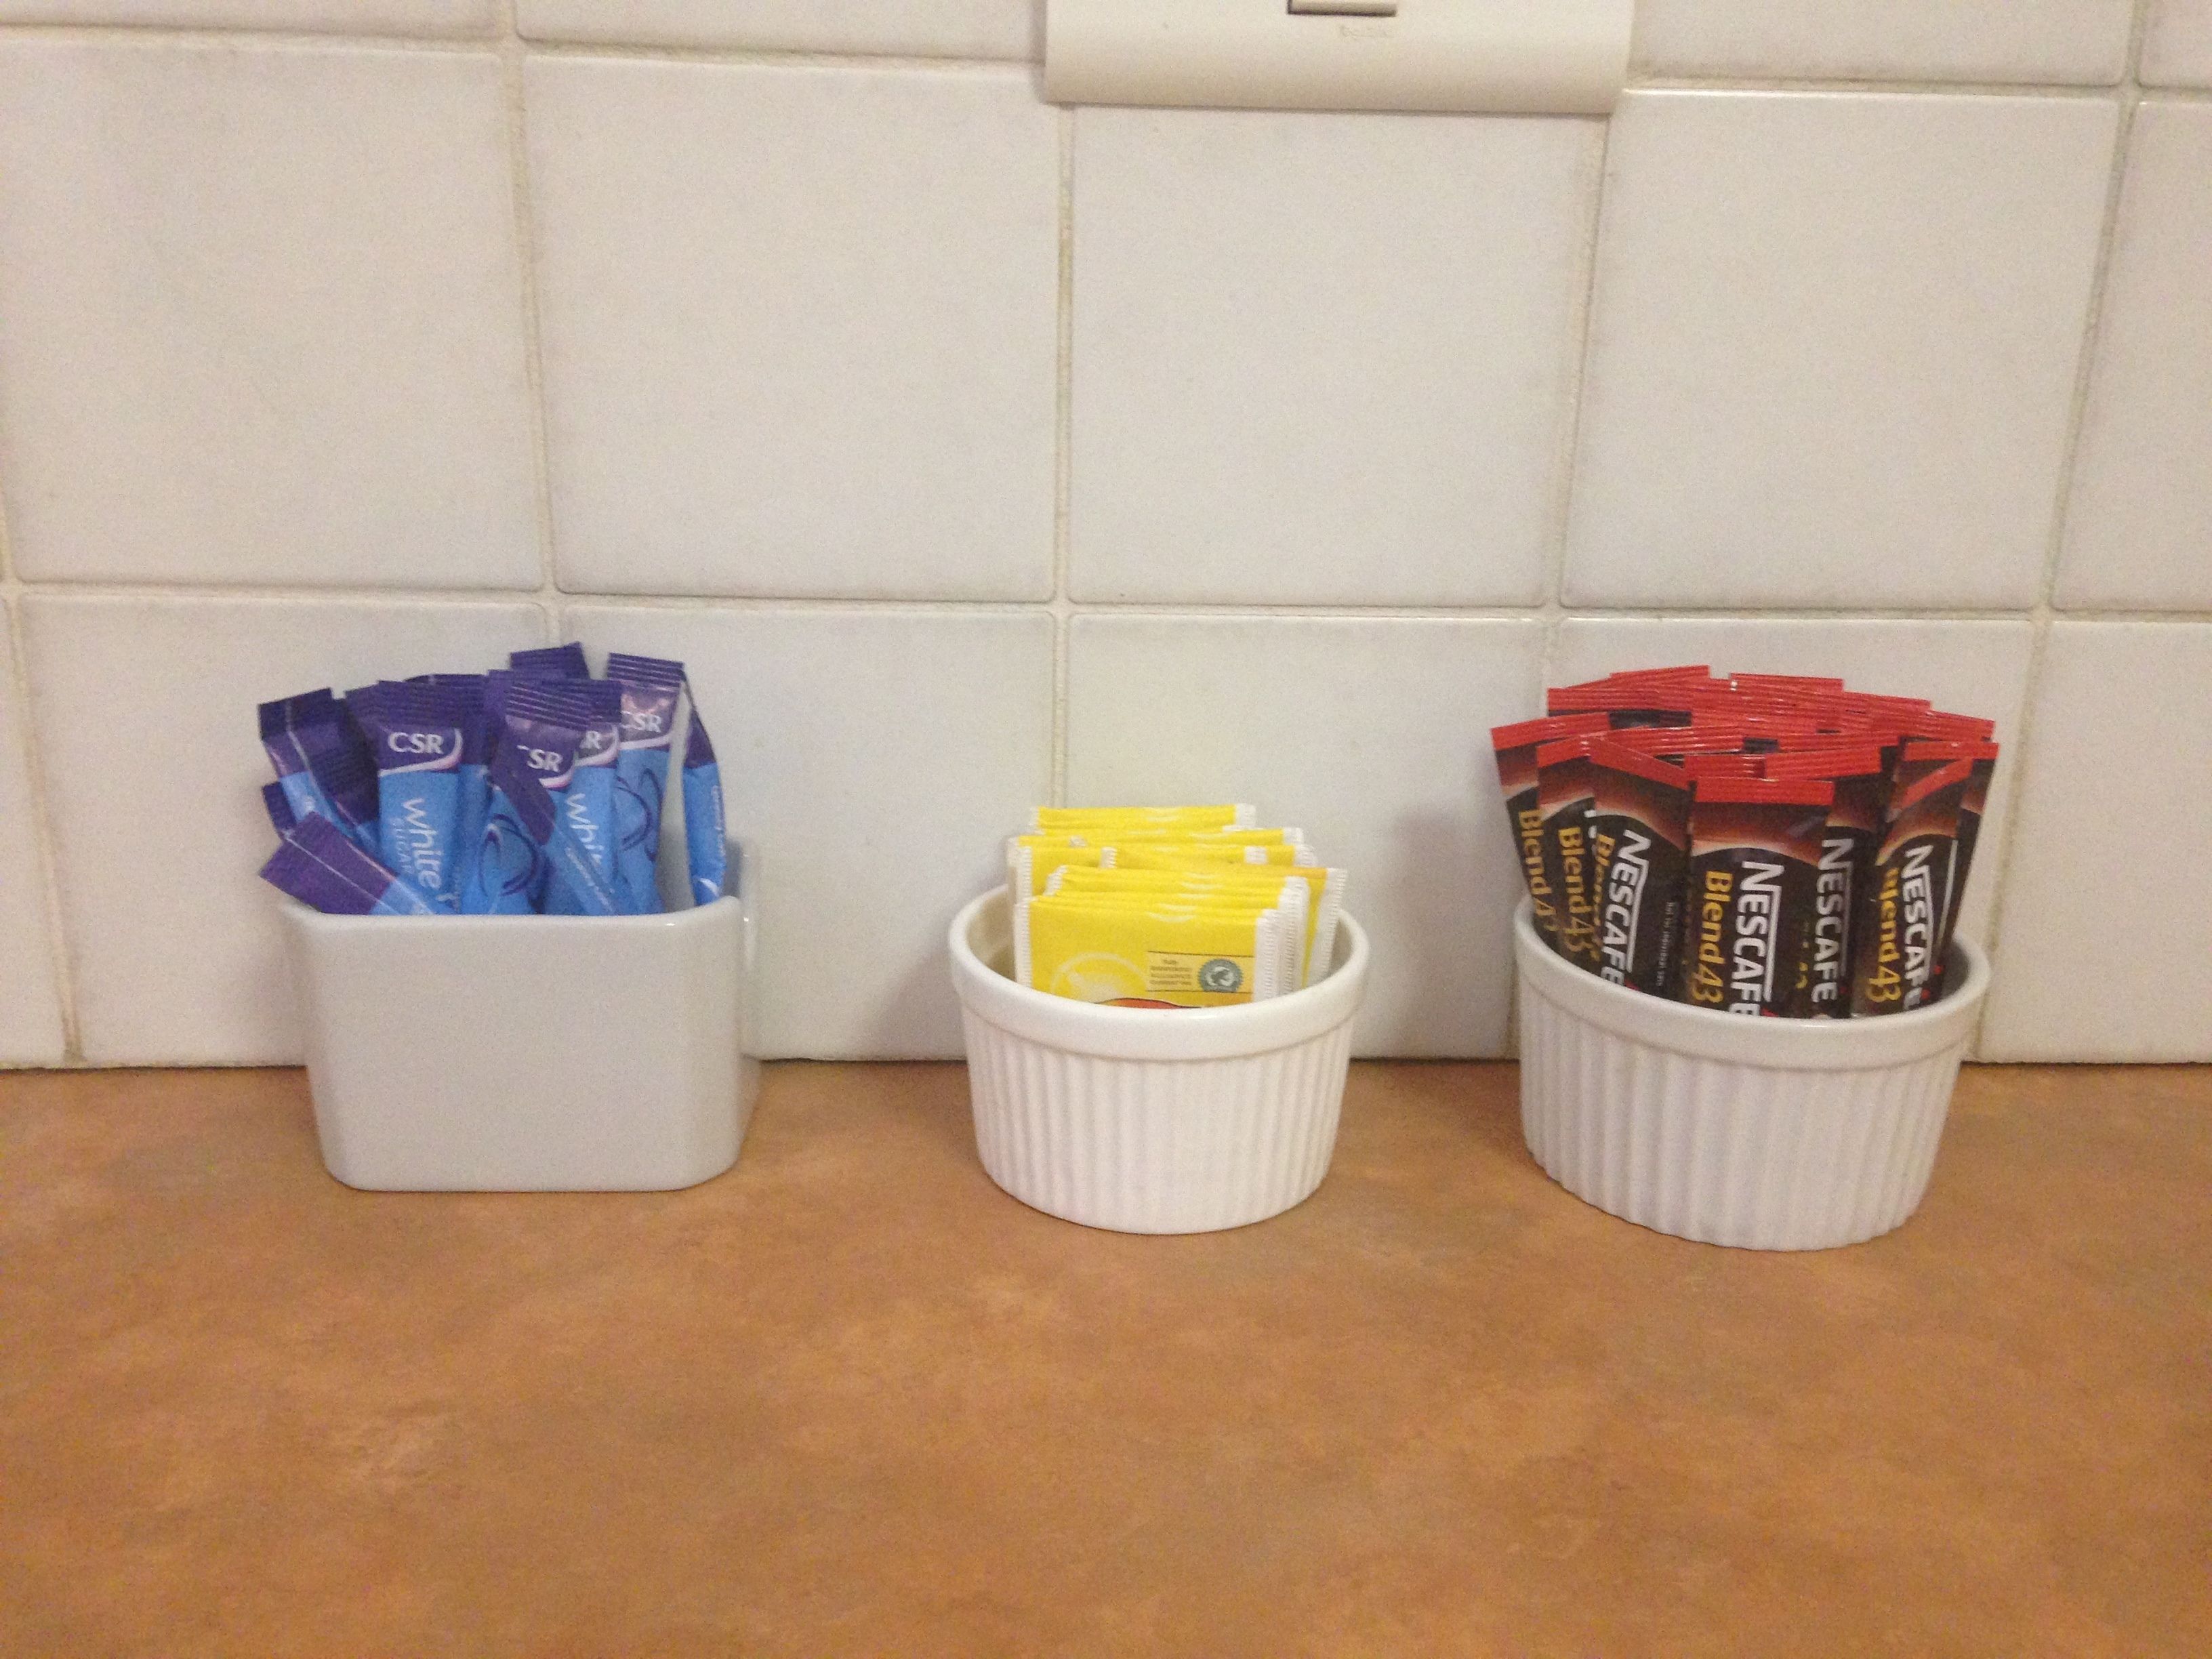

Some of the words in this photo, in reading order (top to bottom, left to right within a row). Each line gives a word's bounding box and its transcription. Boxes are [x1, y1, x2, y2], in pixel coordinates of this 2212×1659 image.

[388, 731, 445, 755] CSR
[516, 744, 564, 773] SR
[403, 797, 445, 890] white
[1518, 809, 1553, 895] Blend
[1558, 826, 1593, 914] Blend
[1698, 870, 1734, 964] Blend
[1690, 963, 1724, 1003] 43
[1866, 964, 1902, 1003] 43
